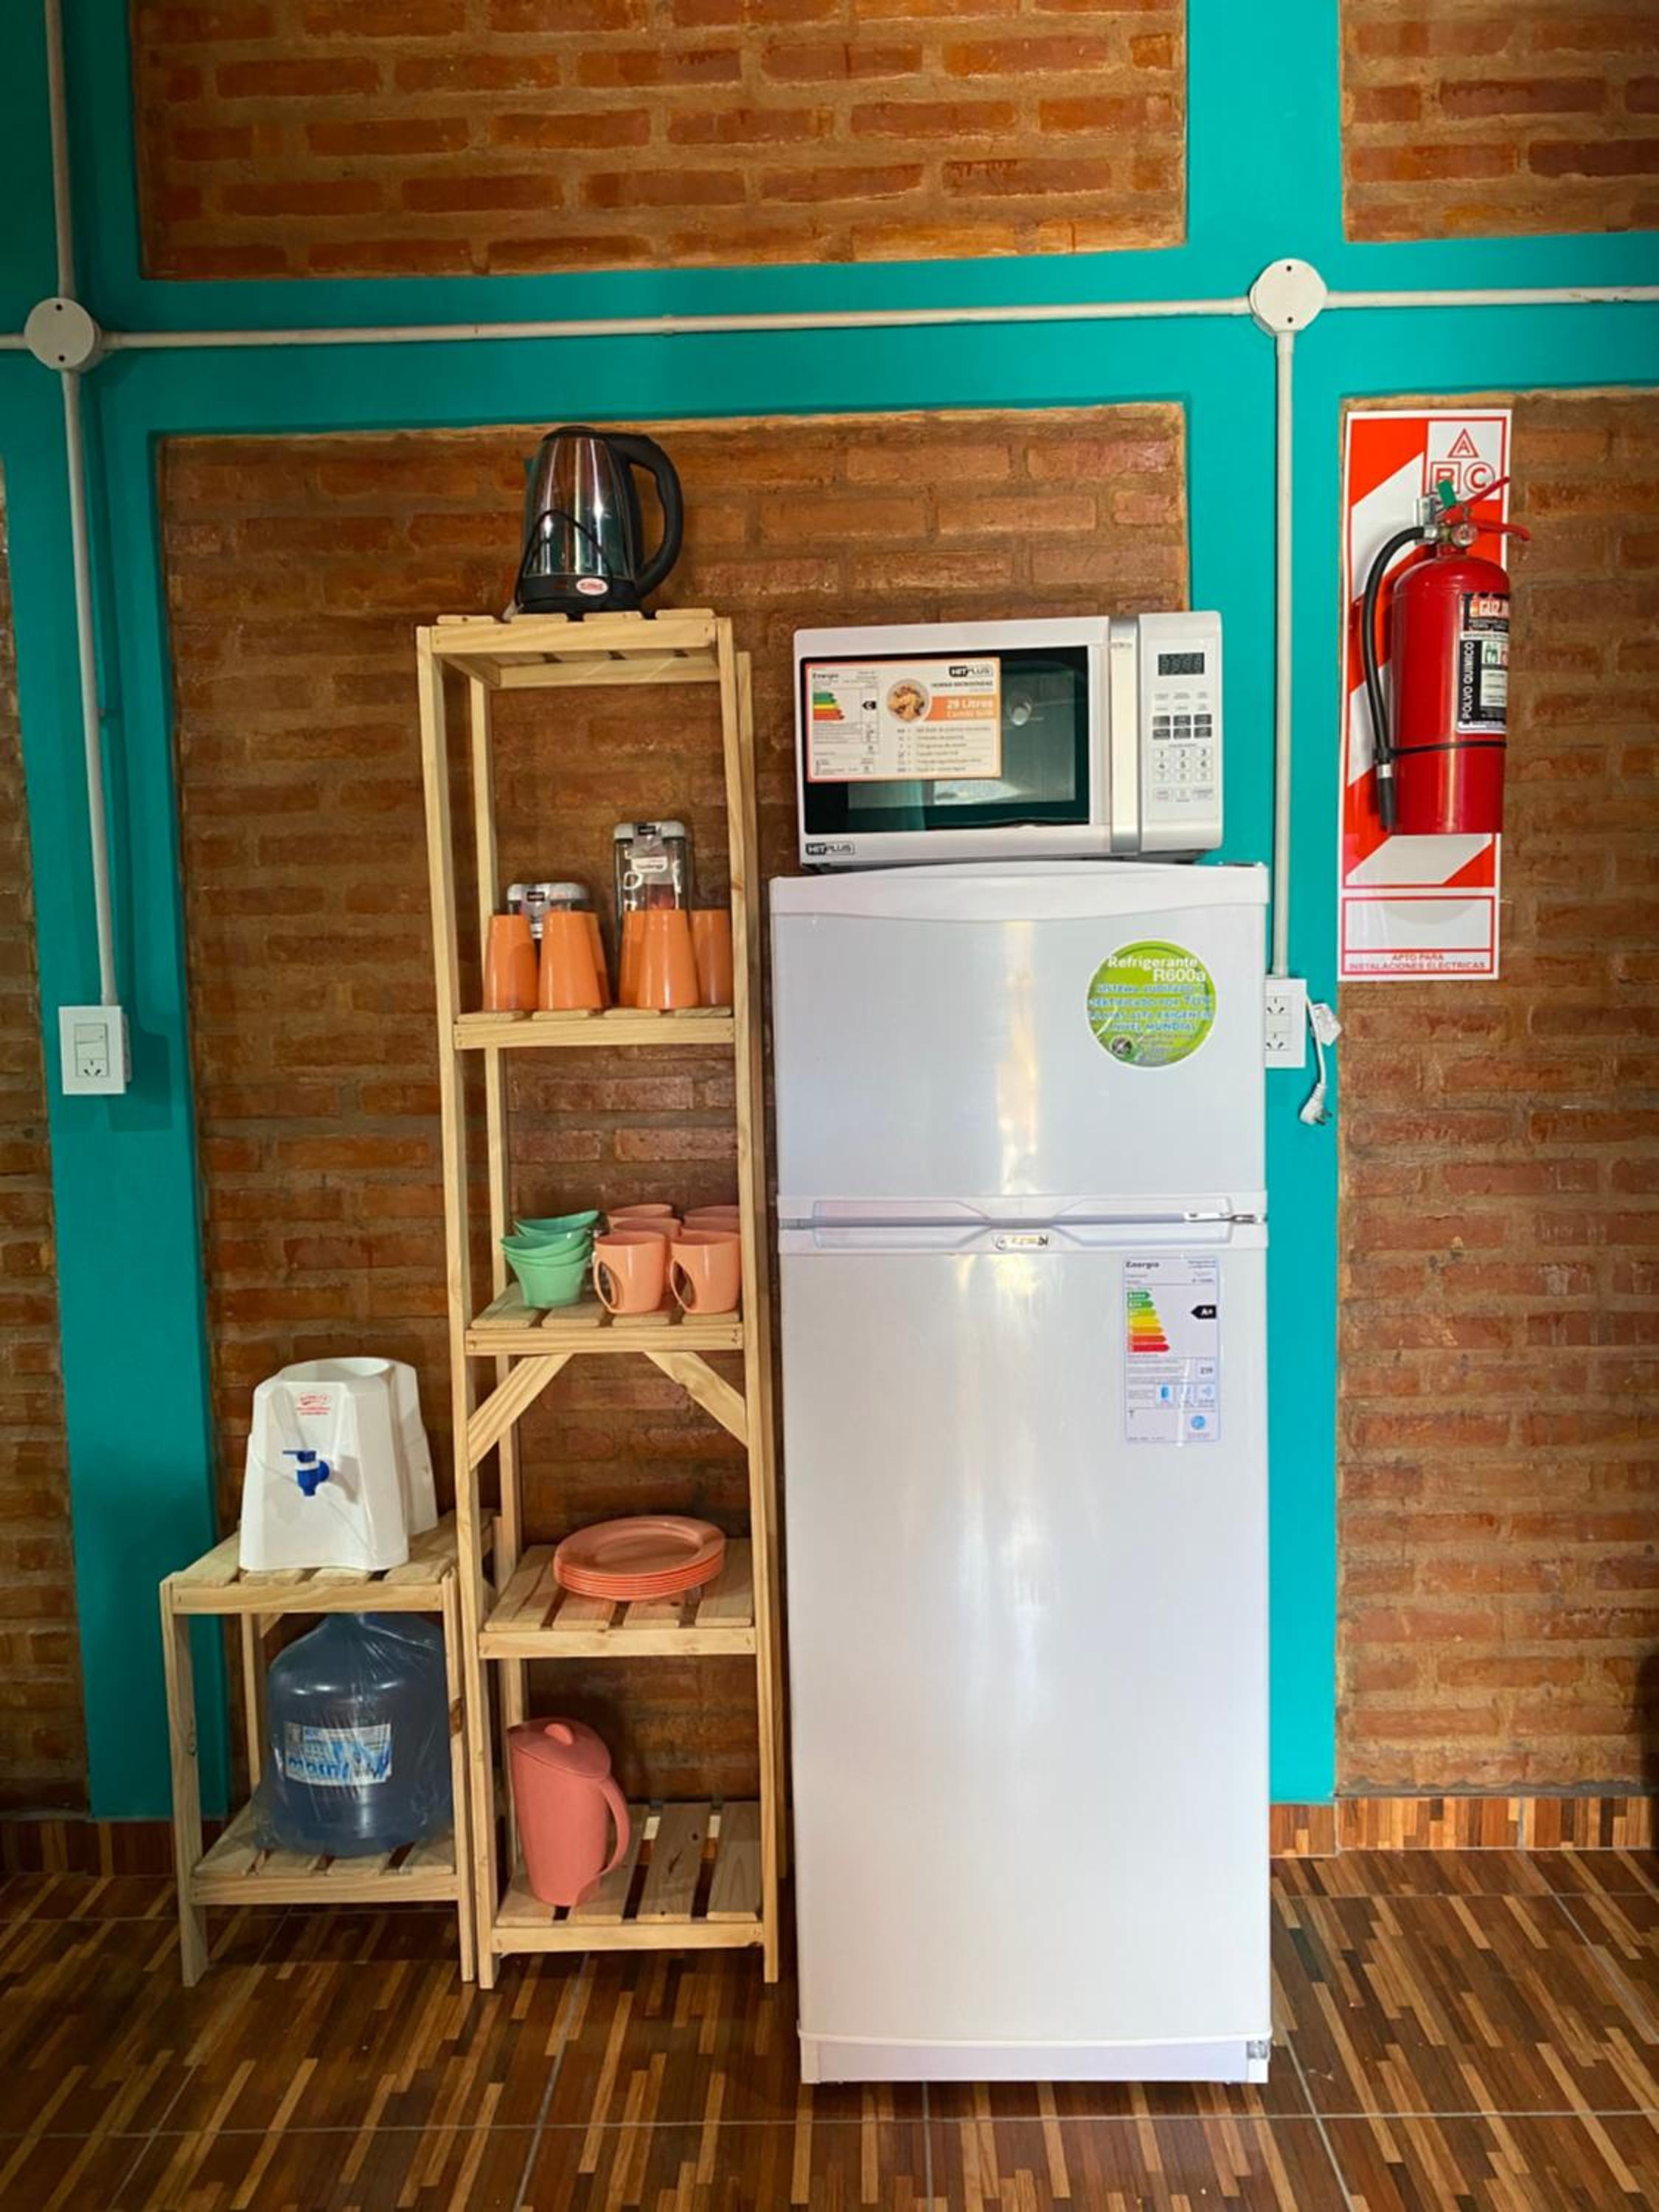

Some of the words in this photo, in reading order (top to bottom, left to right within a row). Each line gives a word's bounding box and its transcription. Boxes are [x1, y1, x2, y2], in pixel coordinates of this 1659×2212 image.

[1457, 440, 1470, 453] A
[1470, 467, 1487, 489] C
[1462, 686, 1473, 719] POLVO
[1107, 956, 1198, 970] Refrigerante
[1349, 961, 1424, 970] INSTALACIONES
[1152, 968, 1206, 982] R600a
